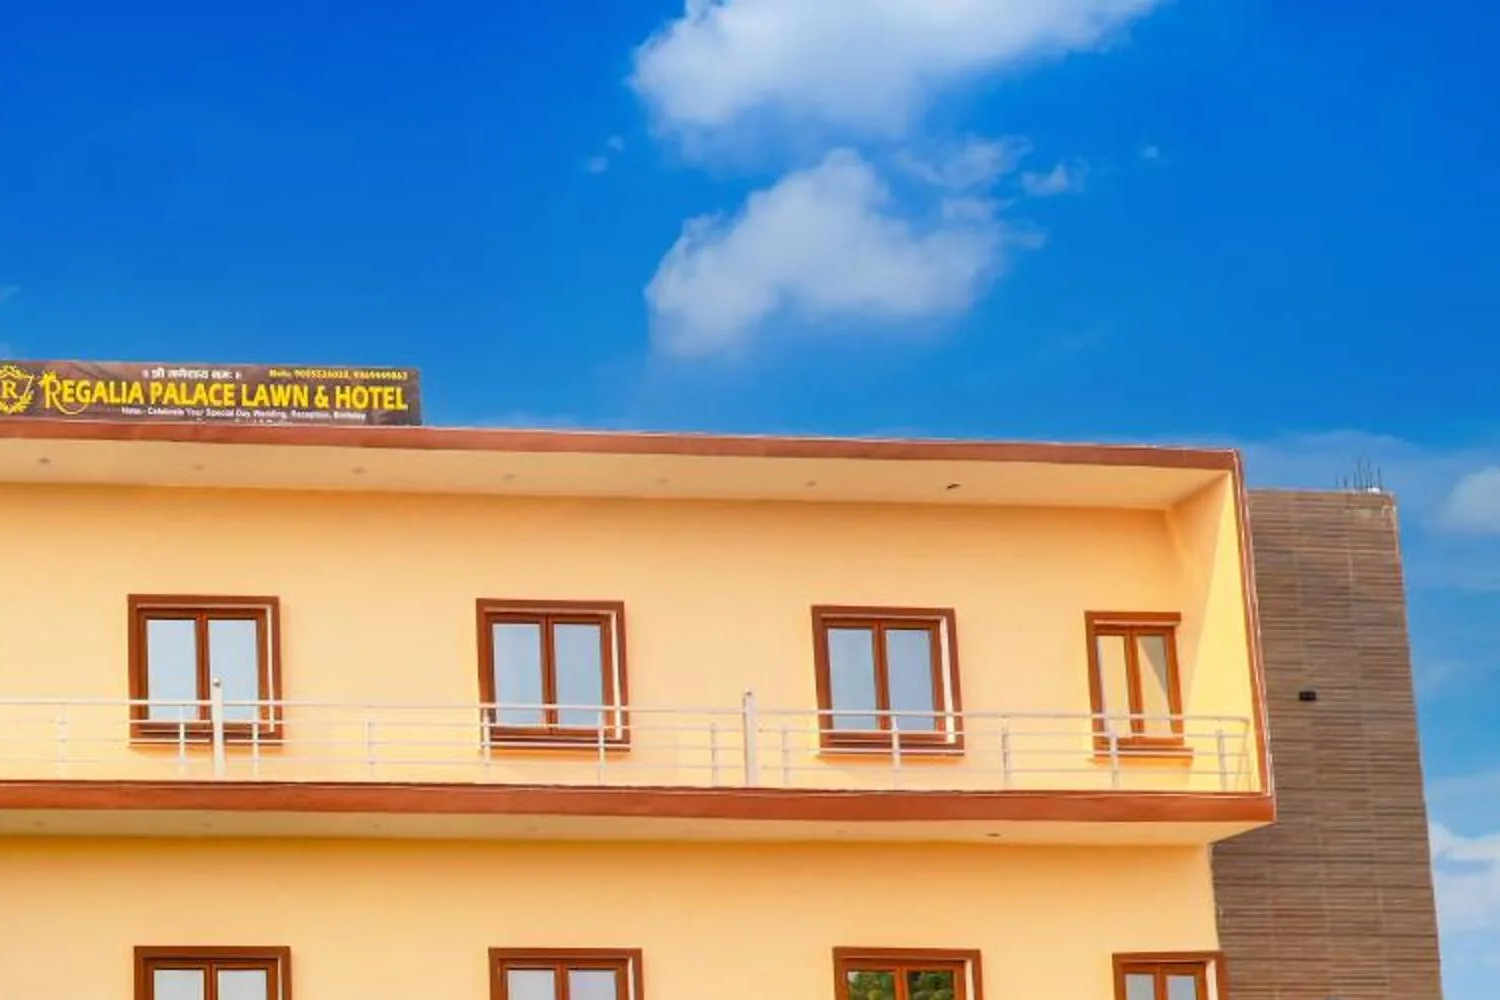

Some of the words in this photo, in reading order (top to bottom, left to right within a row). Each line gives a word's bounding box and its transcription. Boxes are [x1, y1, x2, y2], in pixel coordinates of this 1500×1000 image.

[39, 371, 145, 415] REGALIA
[150, 381, 236, 408] PALACE
[241, 383, 309, 408] LAWN
[314, 385, 329, 408] &
[335, 385, 409, 411] HOTEL
